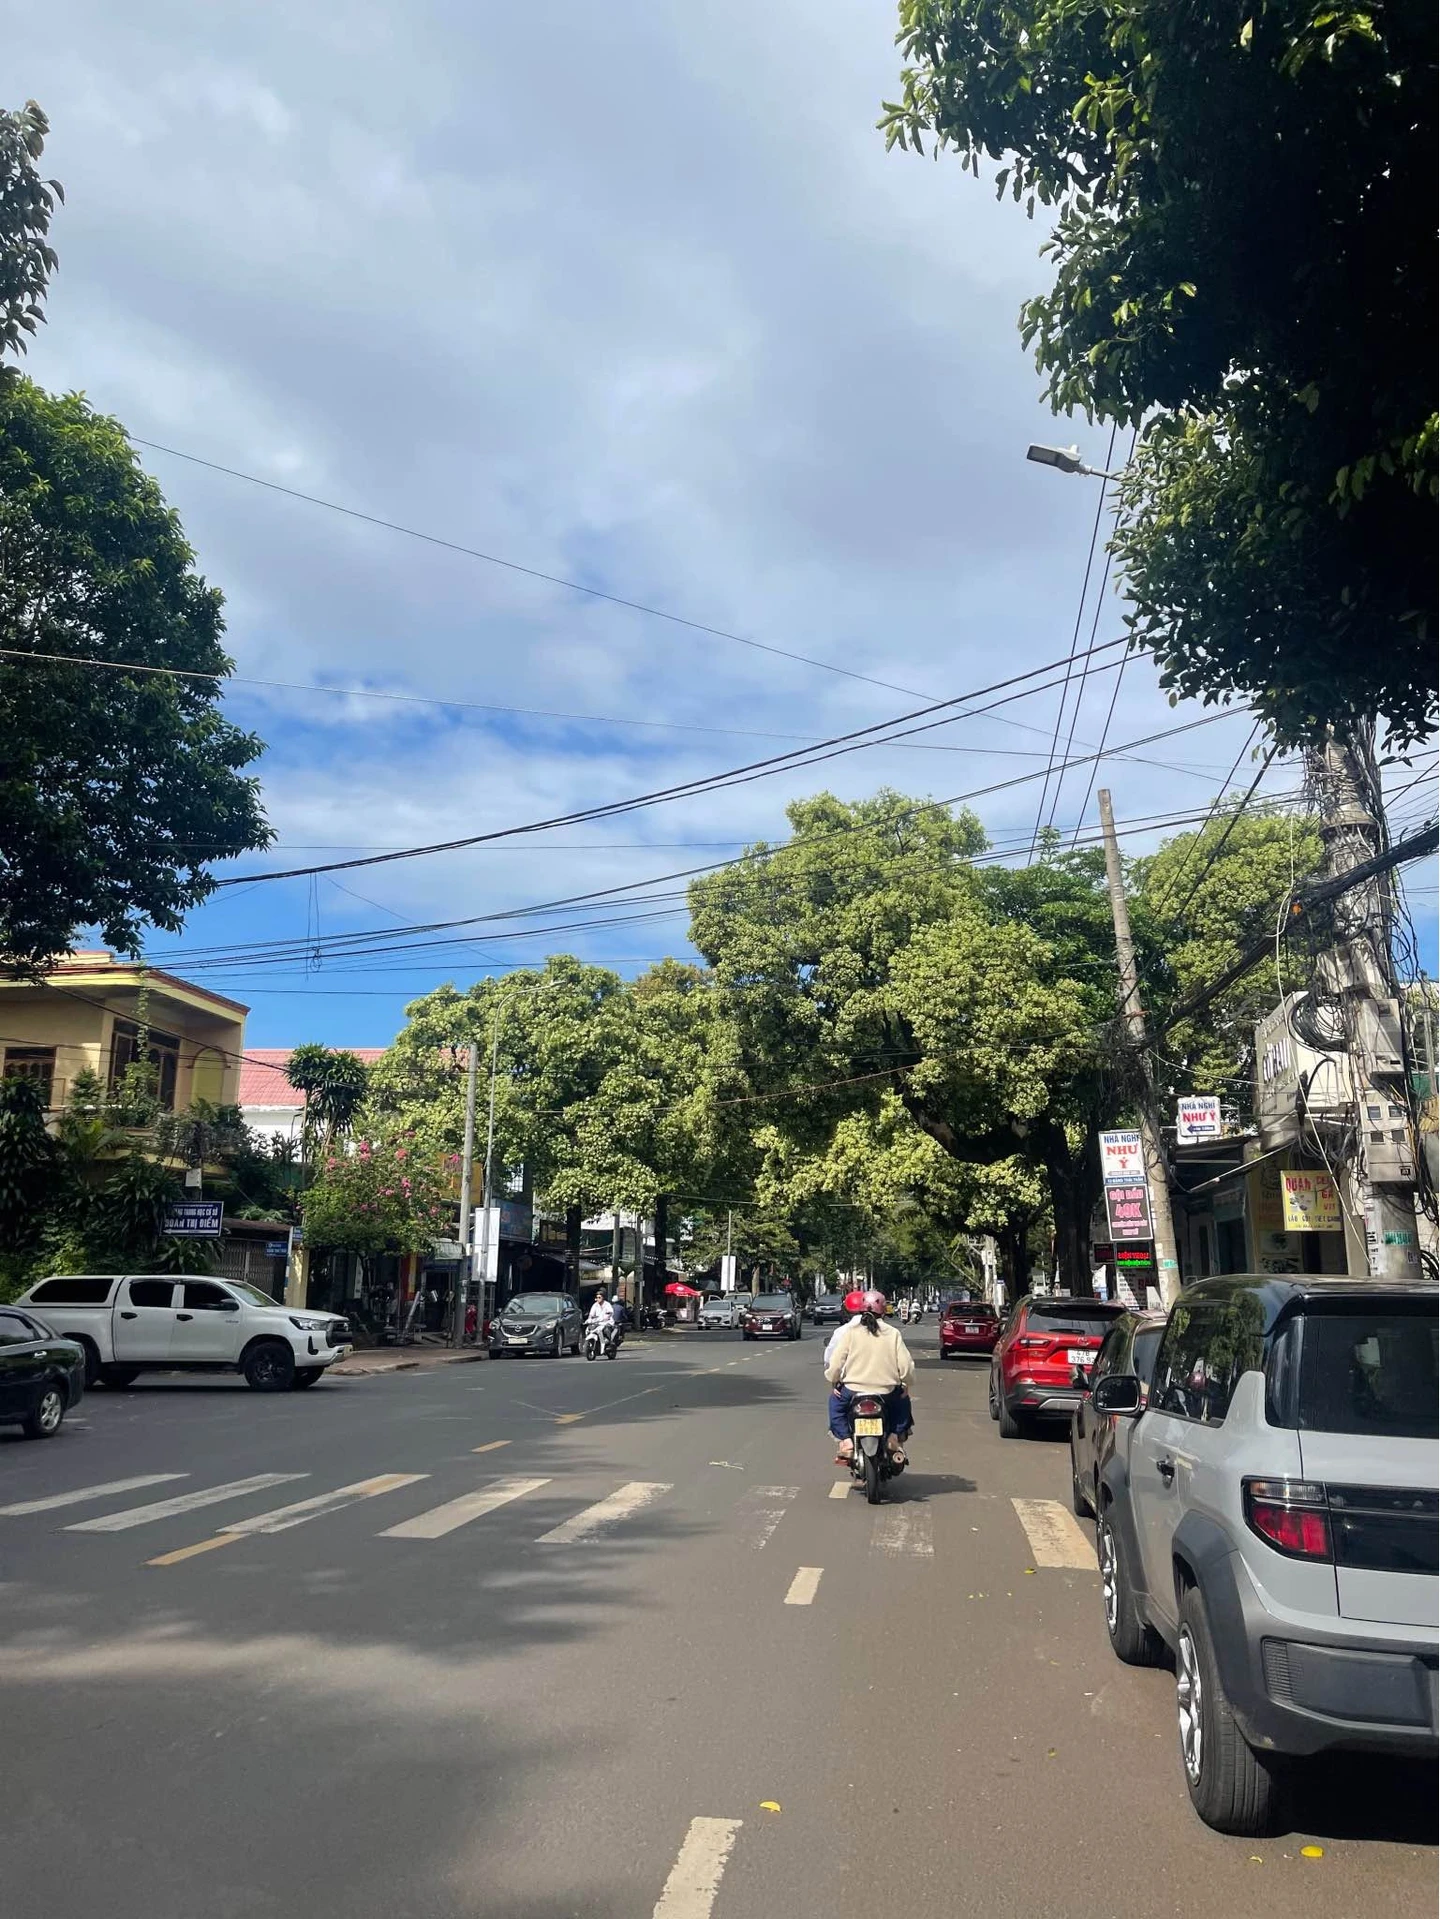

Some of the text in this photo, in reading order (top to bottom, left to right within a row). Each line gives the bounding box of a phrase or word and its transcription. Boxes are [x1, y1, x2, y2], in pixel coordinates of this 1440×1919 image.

[1181, 1101, 1196, 1110] NHÀ
[1182, 1111, 1208, 1122] NHƯ
[1104, 1134, 1119, 1144] NHÀ
[1106, 1143, 1138, 1156] NHƯ
